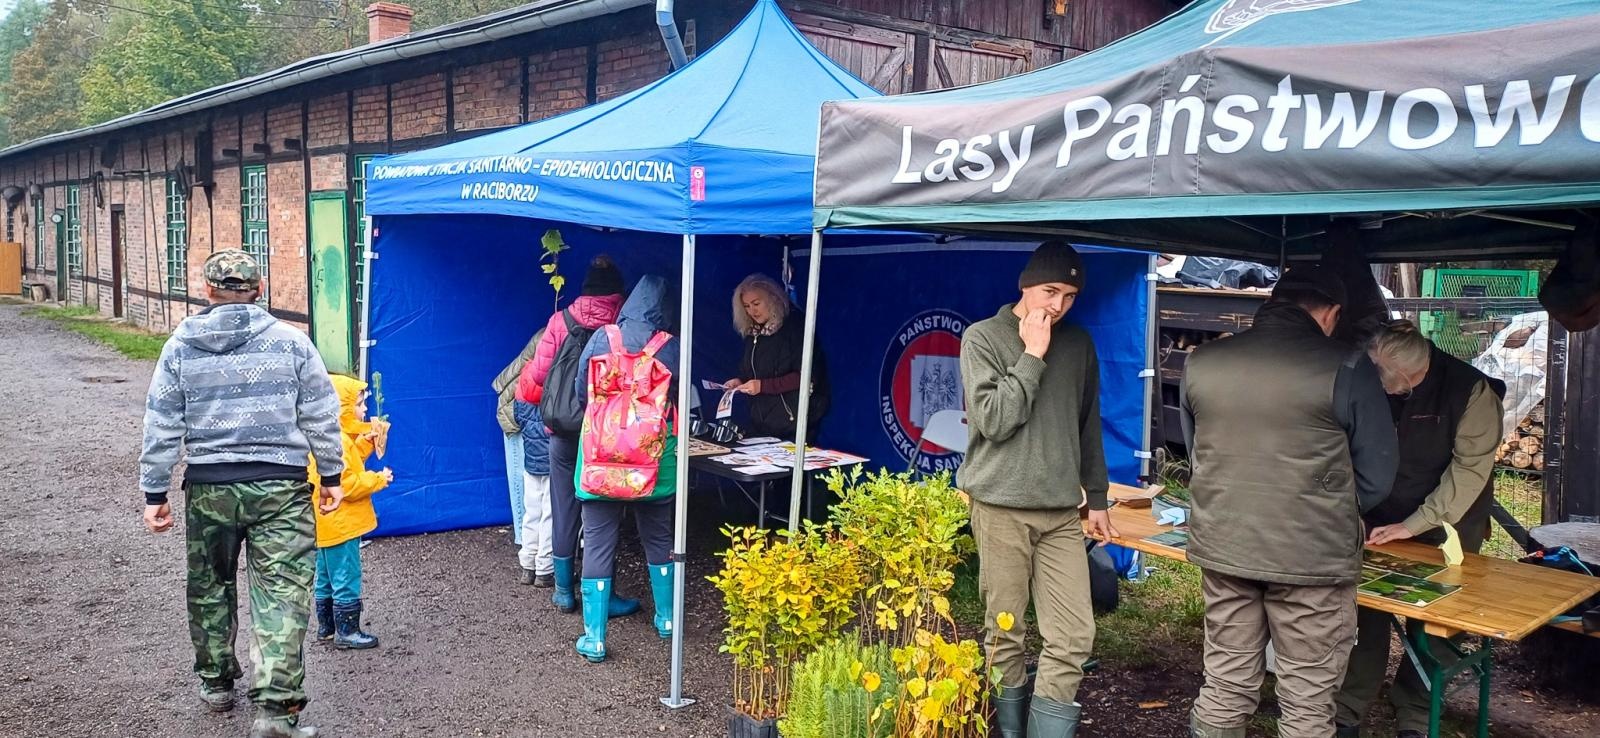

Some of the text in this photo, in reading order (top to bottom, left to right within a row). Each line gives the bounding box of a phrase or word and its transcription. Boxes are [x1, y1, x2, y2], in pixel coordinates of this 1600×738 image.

[429, 161, 469, 176] STACJA
[468, 156, 533, 174] SANITARNO
[540, 159, 675, 183] EPIDEMIOLOGICZNA
[893, 125, 1035, 192] Lasy
[461, 182, 538, 202] W RACIBORZU
[899, 315, 966, 346] PAŃSTWO
